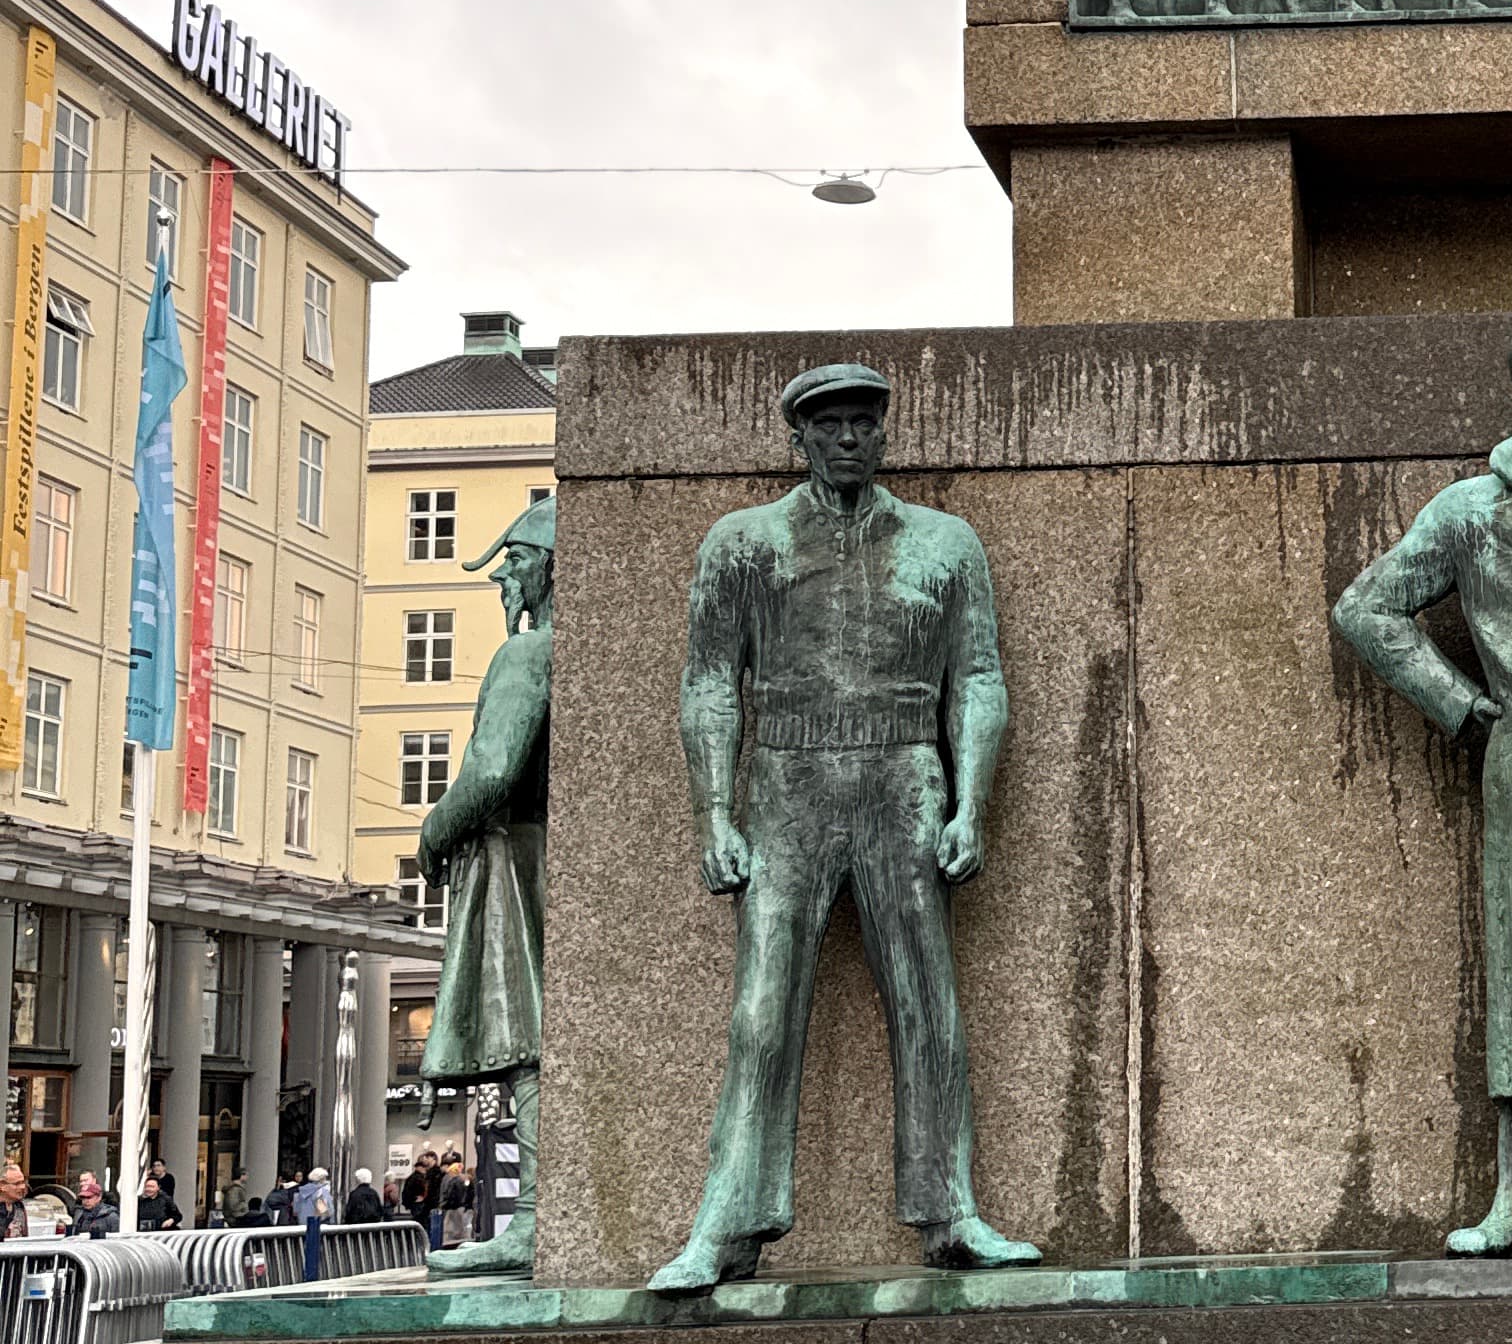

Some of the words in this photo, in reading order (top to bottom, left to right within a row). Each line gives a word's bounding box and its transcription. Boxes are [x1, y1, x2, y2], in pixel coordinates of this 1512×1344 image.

[24, 243, 42, 345] Bergen
[24, 345, 35, 361] i
[13, 369, 34, 540] Festspillene
